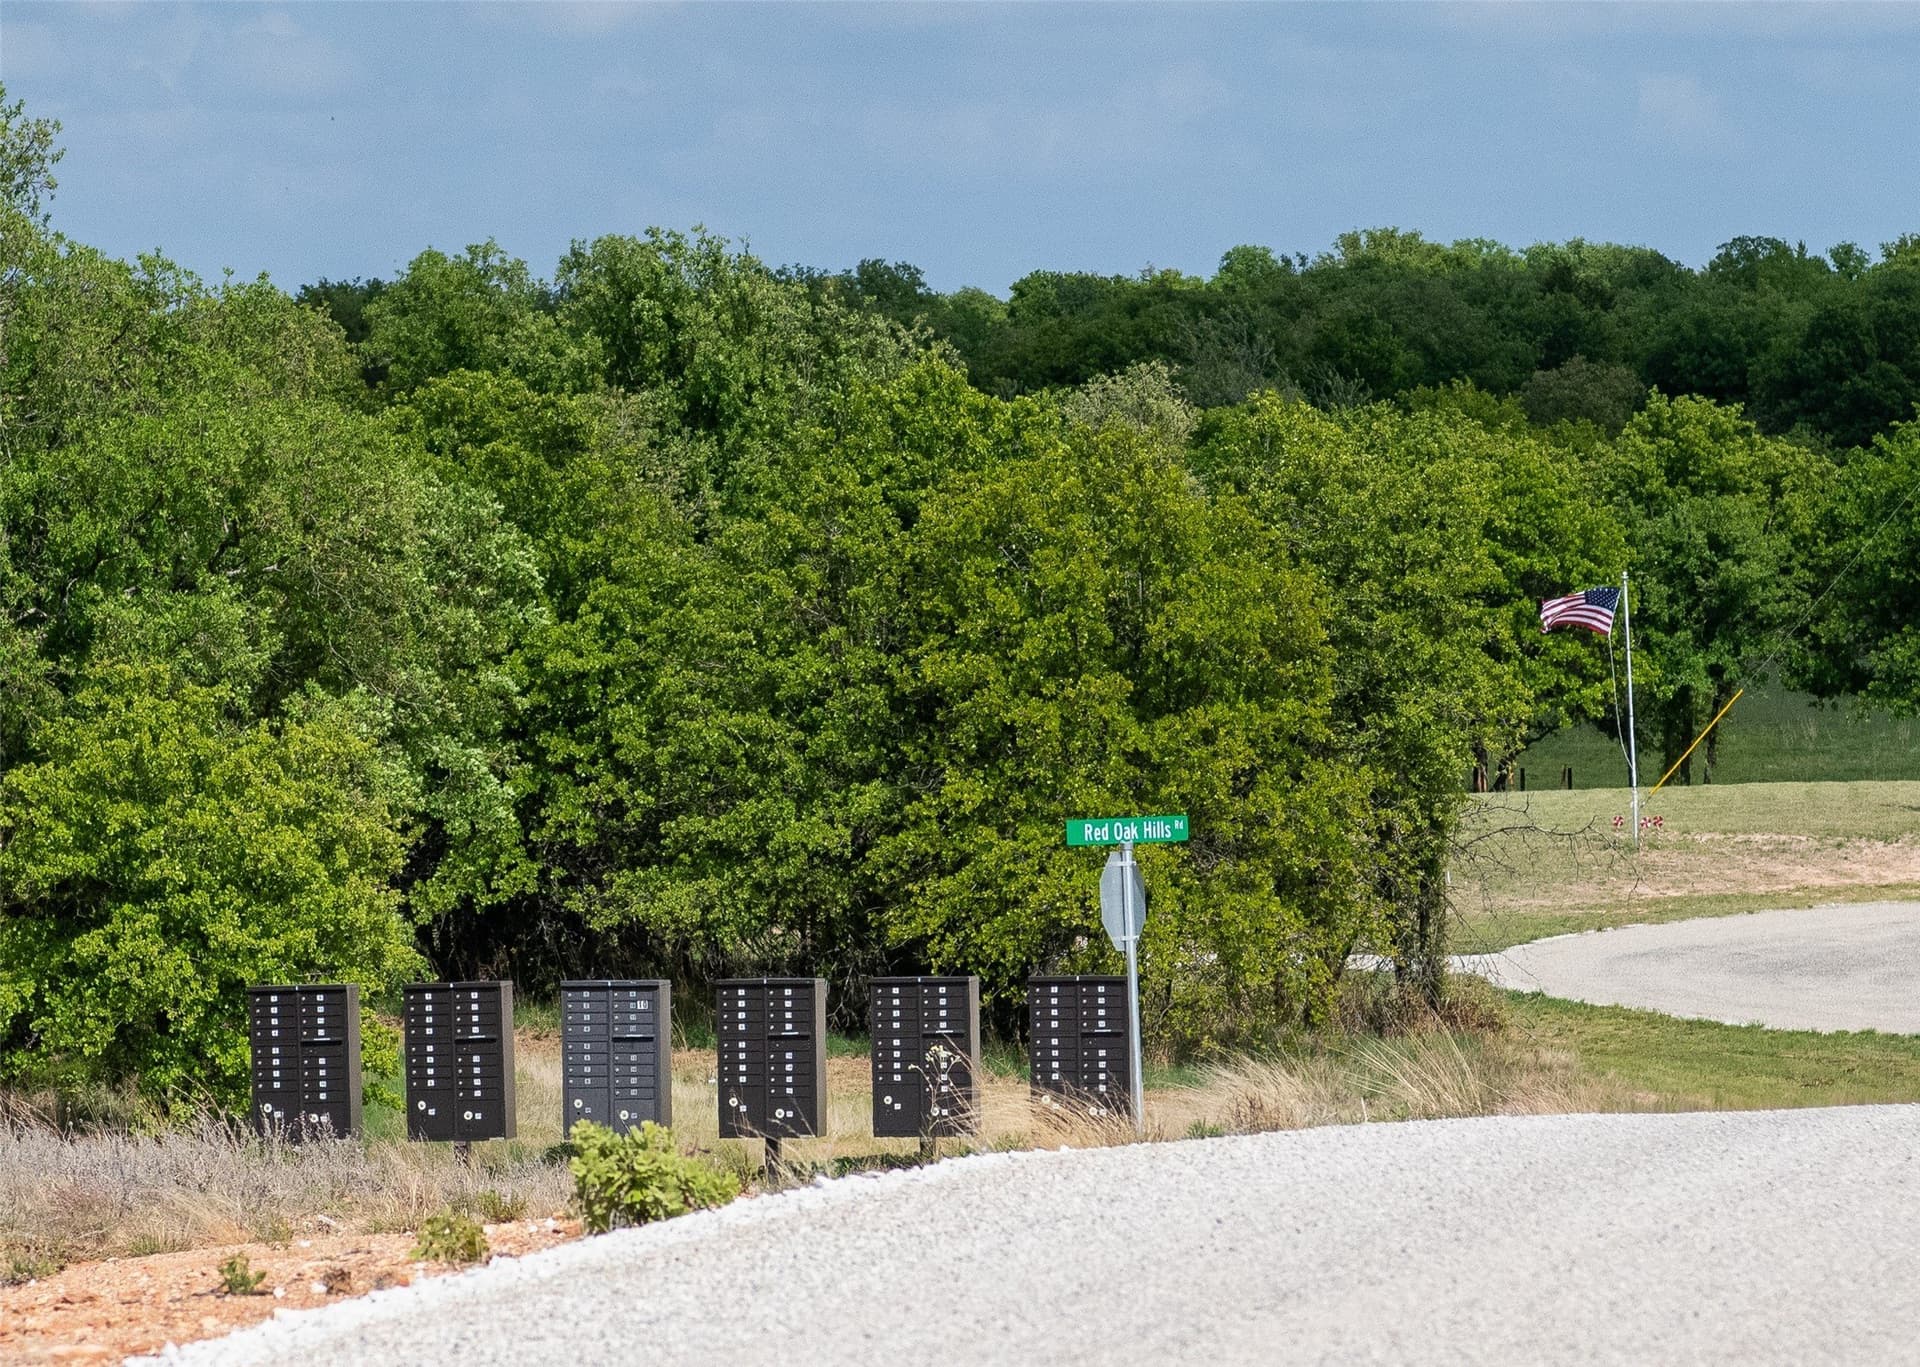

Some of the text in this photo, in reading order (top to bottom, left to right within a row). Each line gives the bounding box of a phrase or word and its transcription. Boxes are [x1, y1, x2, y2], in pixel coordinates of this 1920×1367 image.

[1084, 820, 1184, 841] Red Oak Hills Rd
